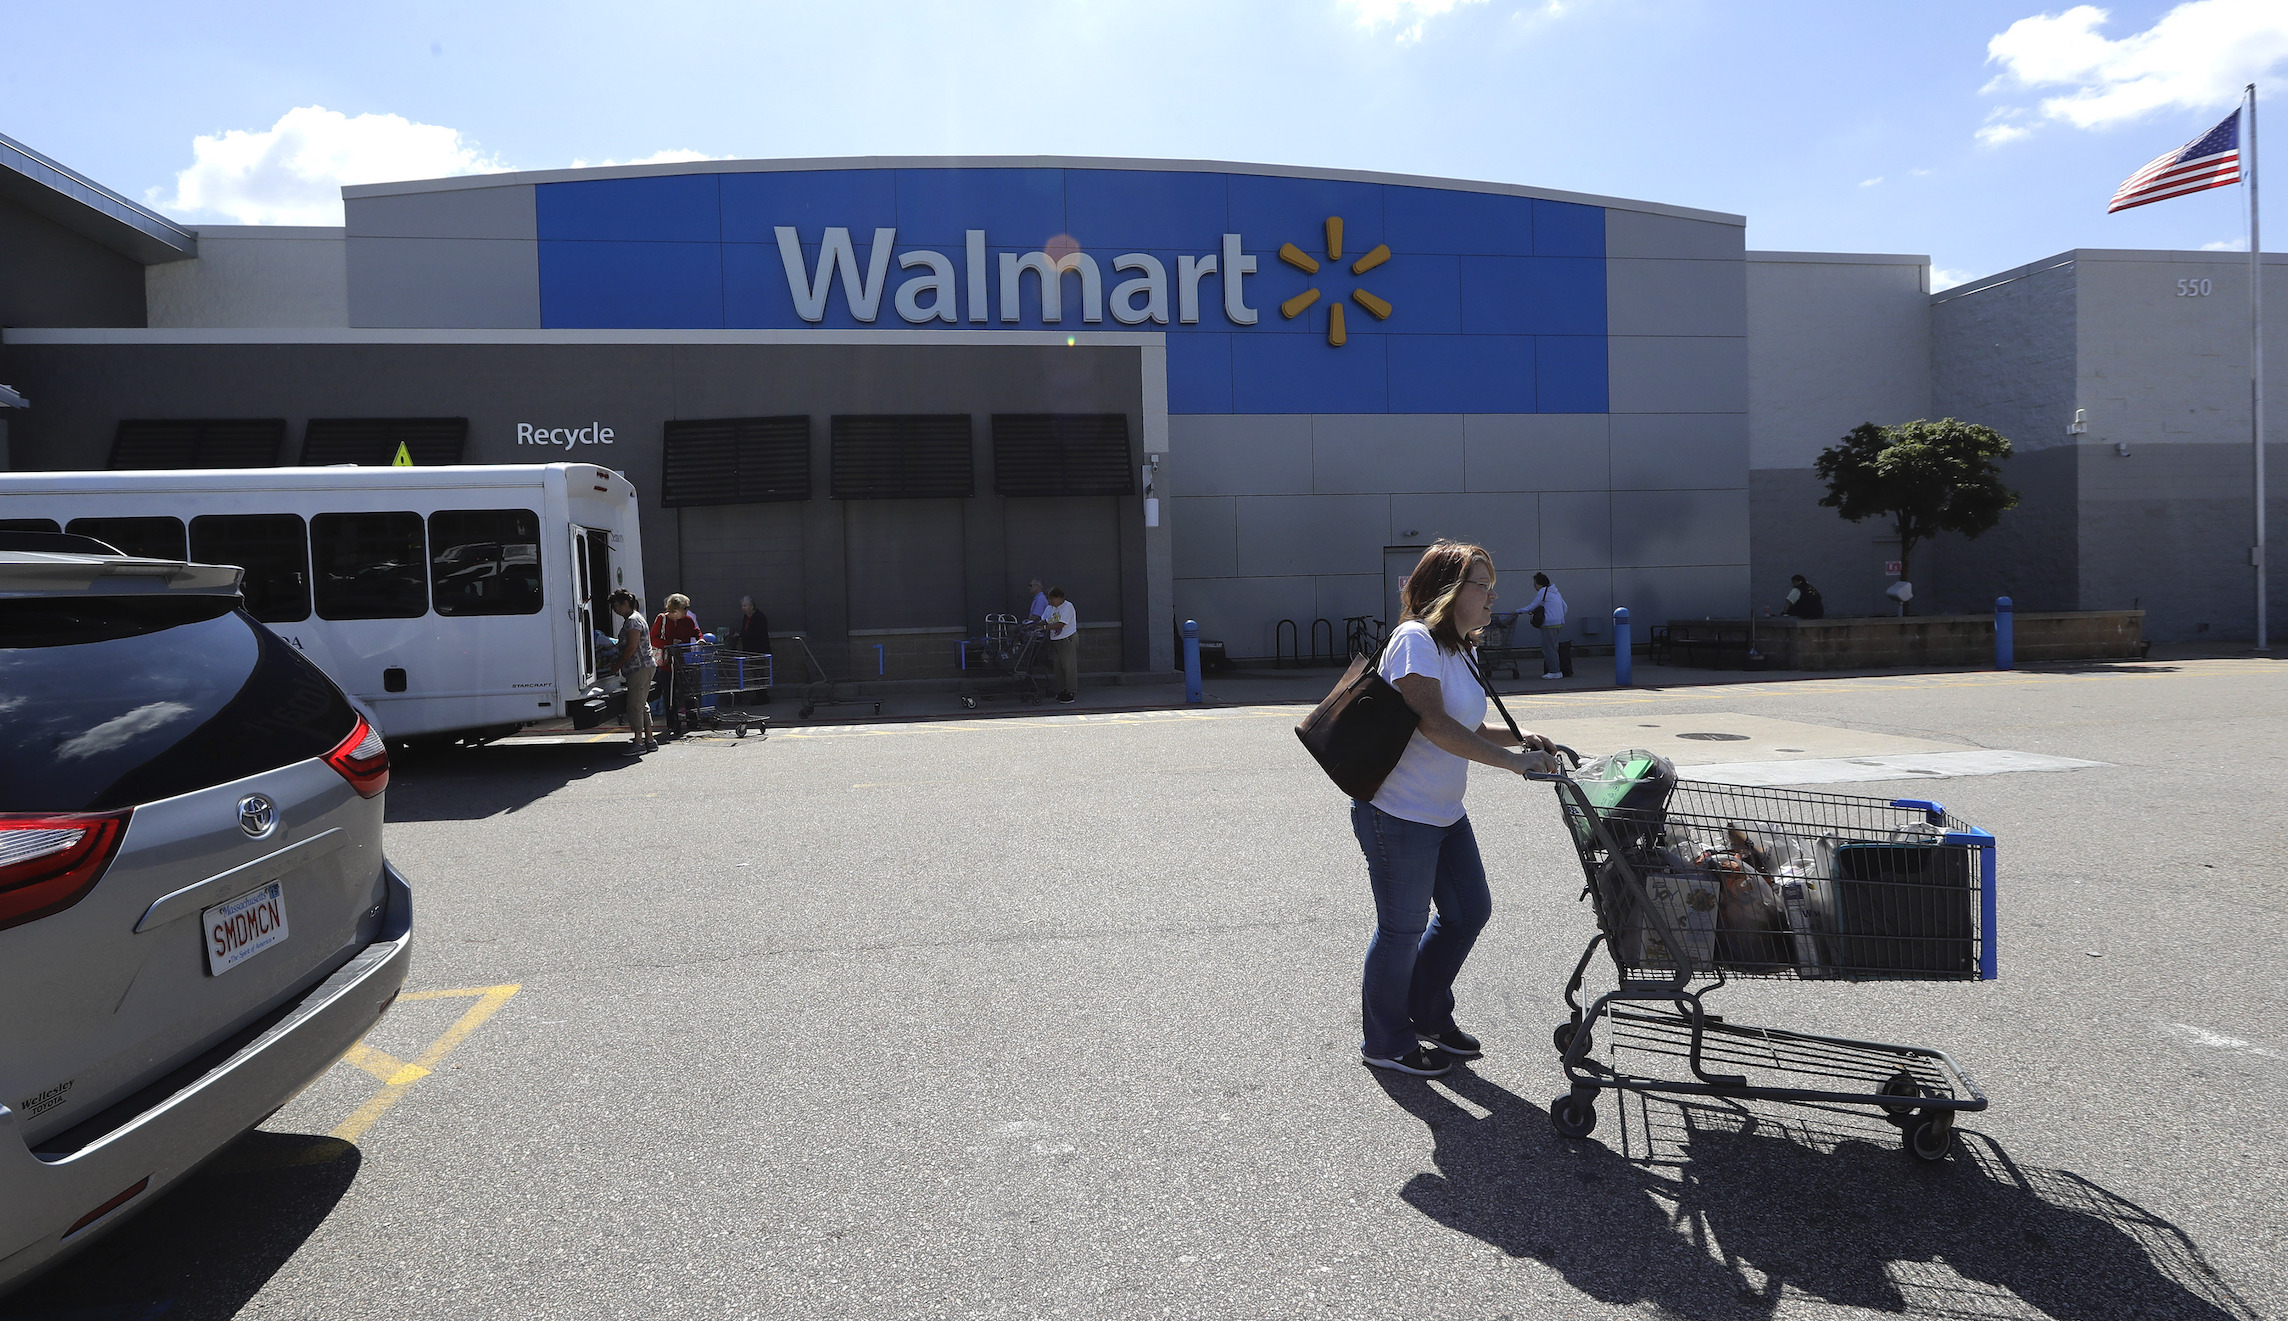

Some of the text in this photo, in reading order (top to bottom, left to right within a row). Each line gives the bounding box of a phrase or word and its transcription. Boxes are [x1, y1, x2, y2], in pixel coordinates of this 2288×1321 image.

[773, 226, 1258, 325] Walmart
[2176, 278, 2211, 297] 550
[517, 421, 614, 451] Recycle
[224, 890, 267, 917] Massachusetts
[213, 898, 280, 957] SMDMCN
[230, 954, 240, 964] The
[239, 948, 250, 959] Spirit
[256, 938, 272, 949] America
[21, 1079, 75, 1110] Wellesley
[32, 1095, 63, 1114] TOYOTA
